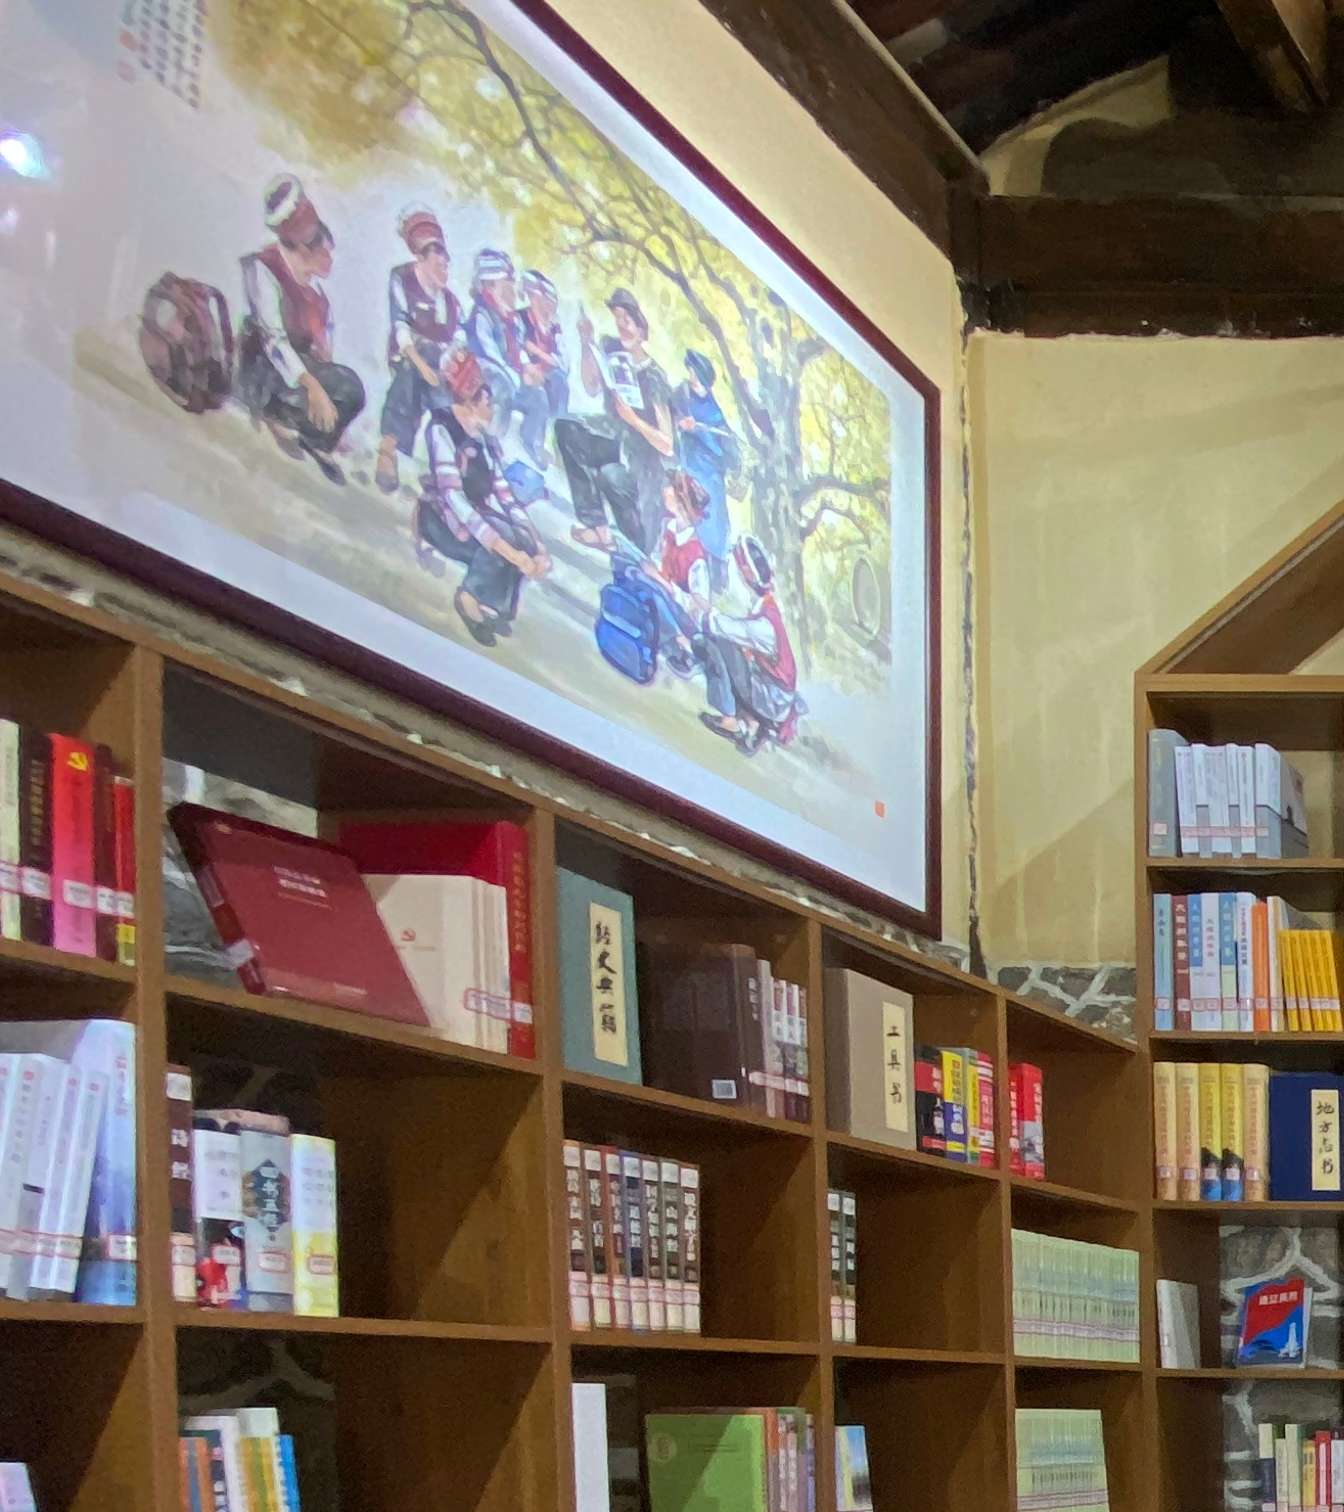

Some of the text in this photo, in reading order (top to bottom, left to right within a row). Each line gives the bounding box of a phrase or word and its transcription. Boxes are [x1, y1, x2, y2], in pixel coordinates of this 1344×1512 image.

[886, 1025, 902, 1104] 工具书
[1315, 1100, 1335, 1176] 地方志书
